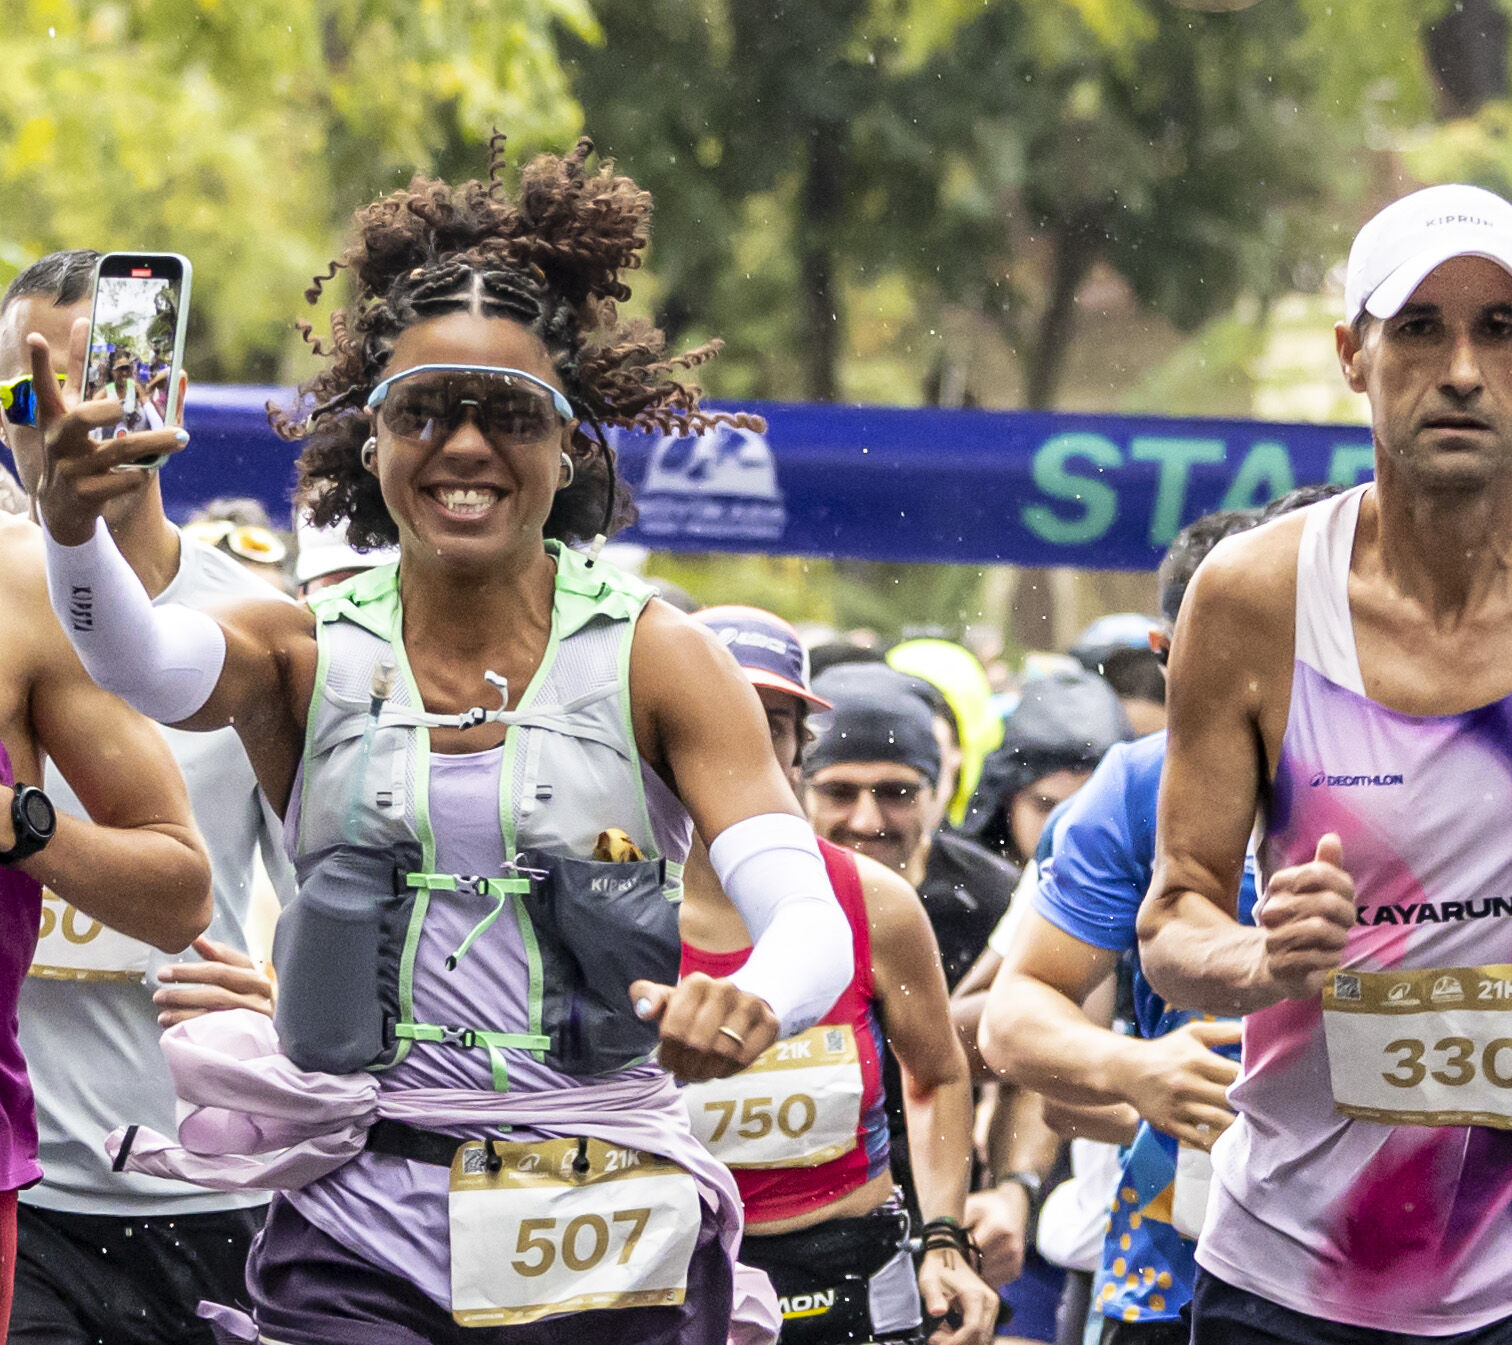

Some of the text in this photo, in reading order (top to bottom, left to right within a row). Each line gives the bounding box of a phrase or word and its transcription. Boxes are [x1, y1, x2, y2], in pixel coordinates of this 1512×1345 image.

[1327, 773, 1404, 787] DECATHLON
[776, 1039, 813, 1062] 21K
[703, 1093, 817, 1144] 750
[510, 1207, 652, 1278] 507
